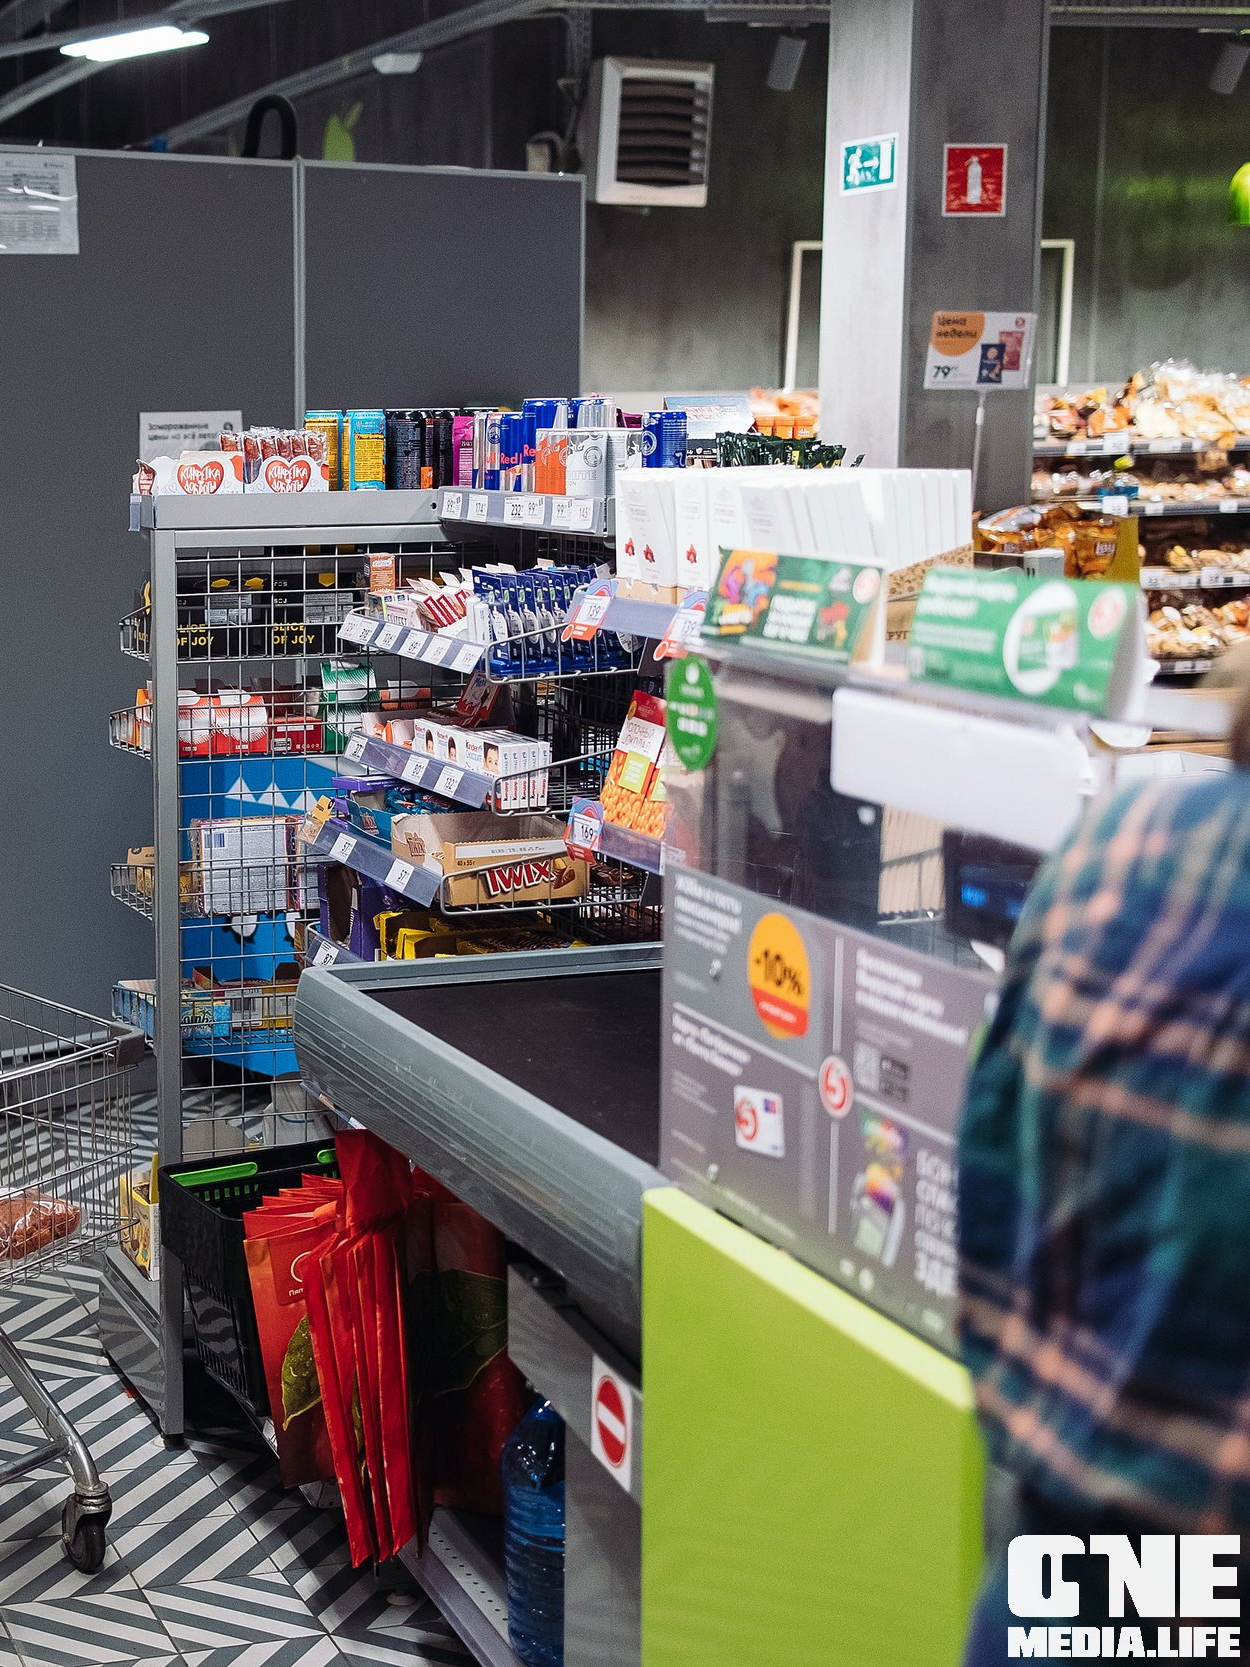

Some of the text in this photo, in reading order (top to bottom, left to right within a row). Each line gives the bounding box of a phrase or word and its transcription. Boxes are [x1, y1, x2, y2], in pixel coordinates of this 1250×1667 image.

[191, 636, 215, 646] JOY
[479, 859, 555, 895] TWIX
[754, 949, 802, 997] -10%
